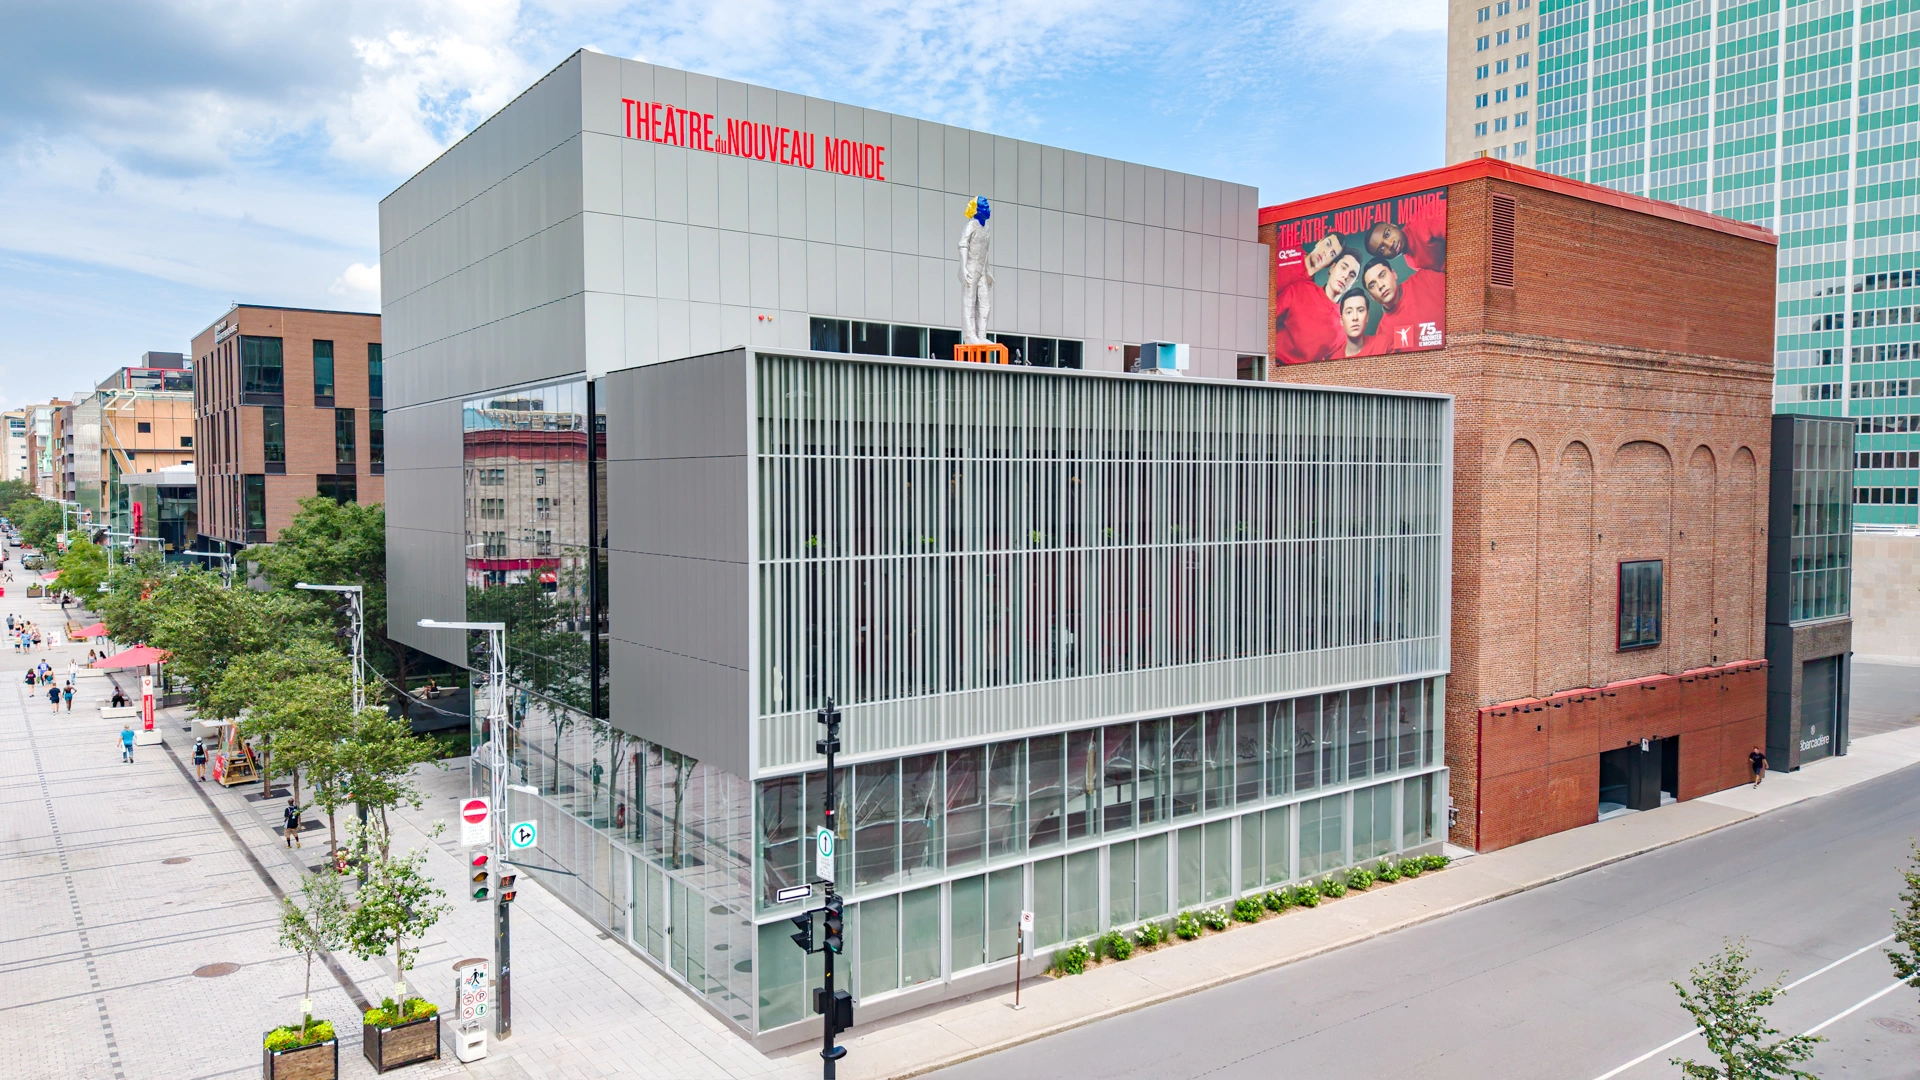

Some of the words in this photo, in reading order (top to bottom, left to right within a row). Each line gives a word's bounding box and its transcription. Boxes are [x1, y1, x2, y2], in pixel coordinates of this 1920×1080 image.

[715, 135, 726, 154] du
[727, 117, 815, 169] NOUVEAU
[825, 136, 885, 181] MONDE
[1397, 191, 1444, 224] MONDE
[1418, 322, 1436, 335] 75
[103, 388, 137, 410] 22
